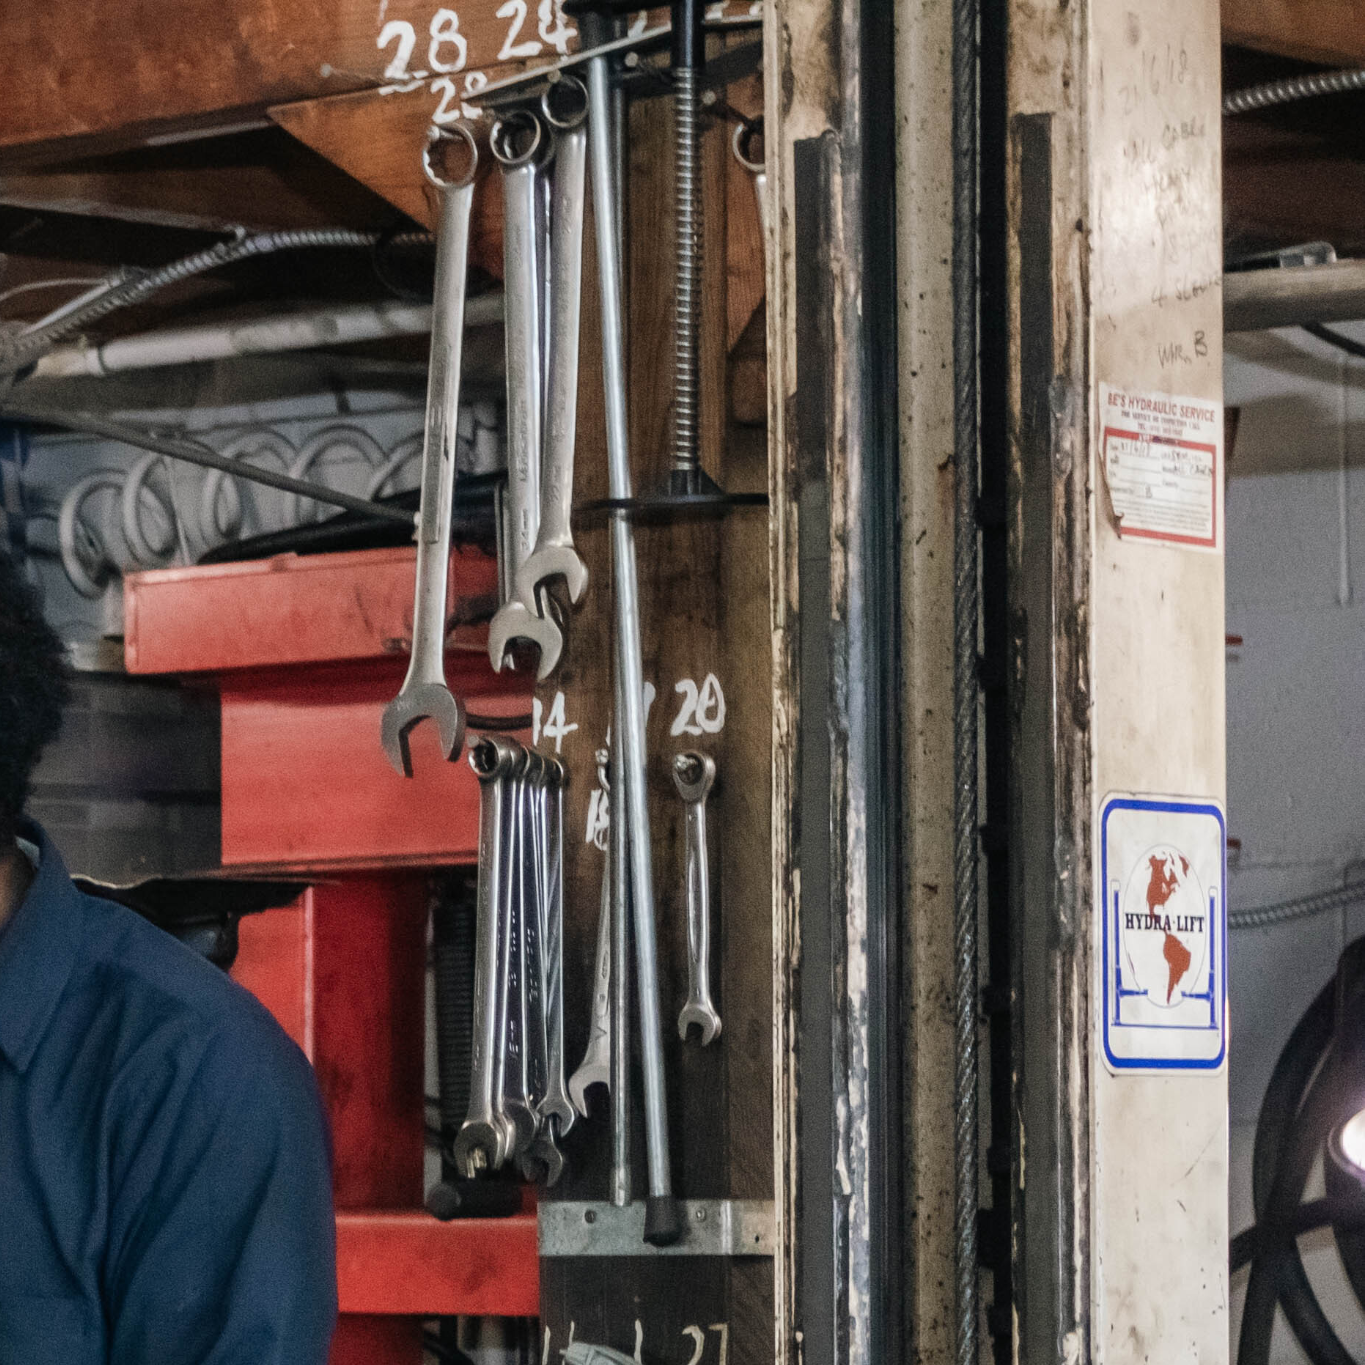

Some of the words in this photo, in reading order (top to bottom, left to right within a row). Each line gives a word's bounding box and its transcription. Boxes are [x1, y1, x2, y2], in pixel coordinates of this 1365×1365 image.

[376, 8, 468, 93] 28
[1128, 396, 1178, 416] HYDRAULIC
[1180, 405, 1215, 422] SERVICE
[532, 690, 579, 754] 14
[670, 672, 727, 736] 20
